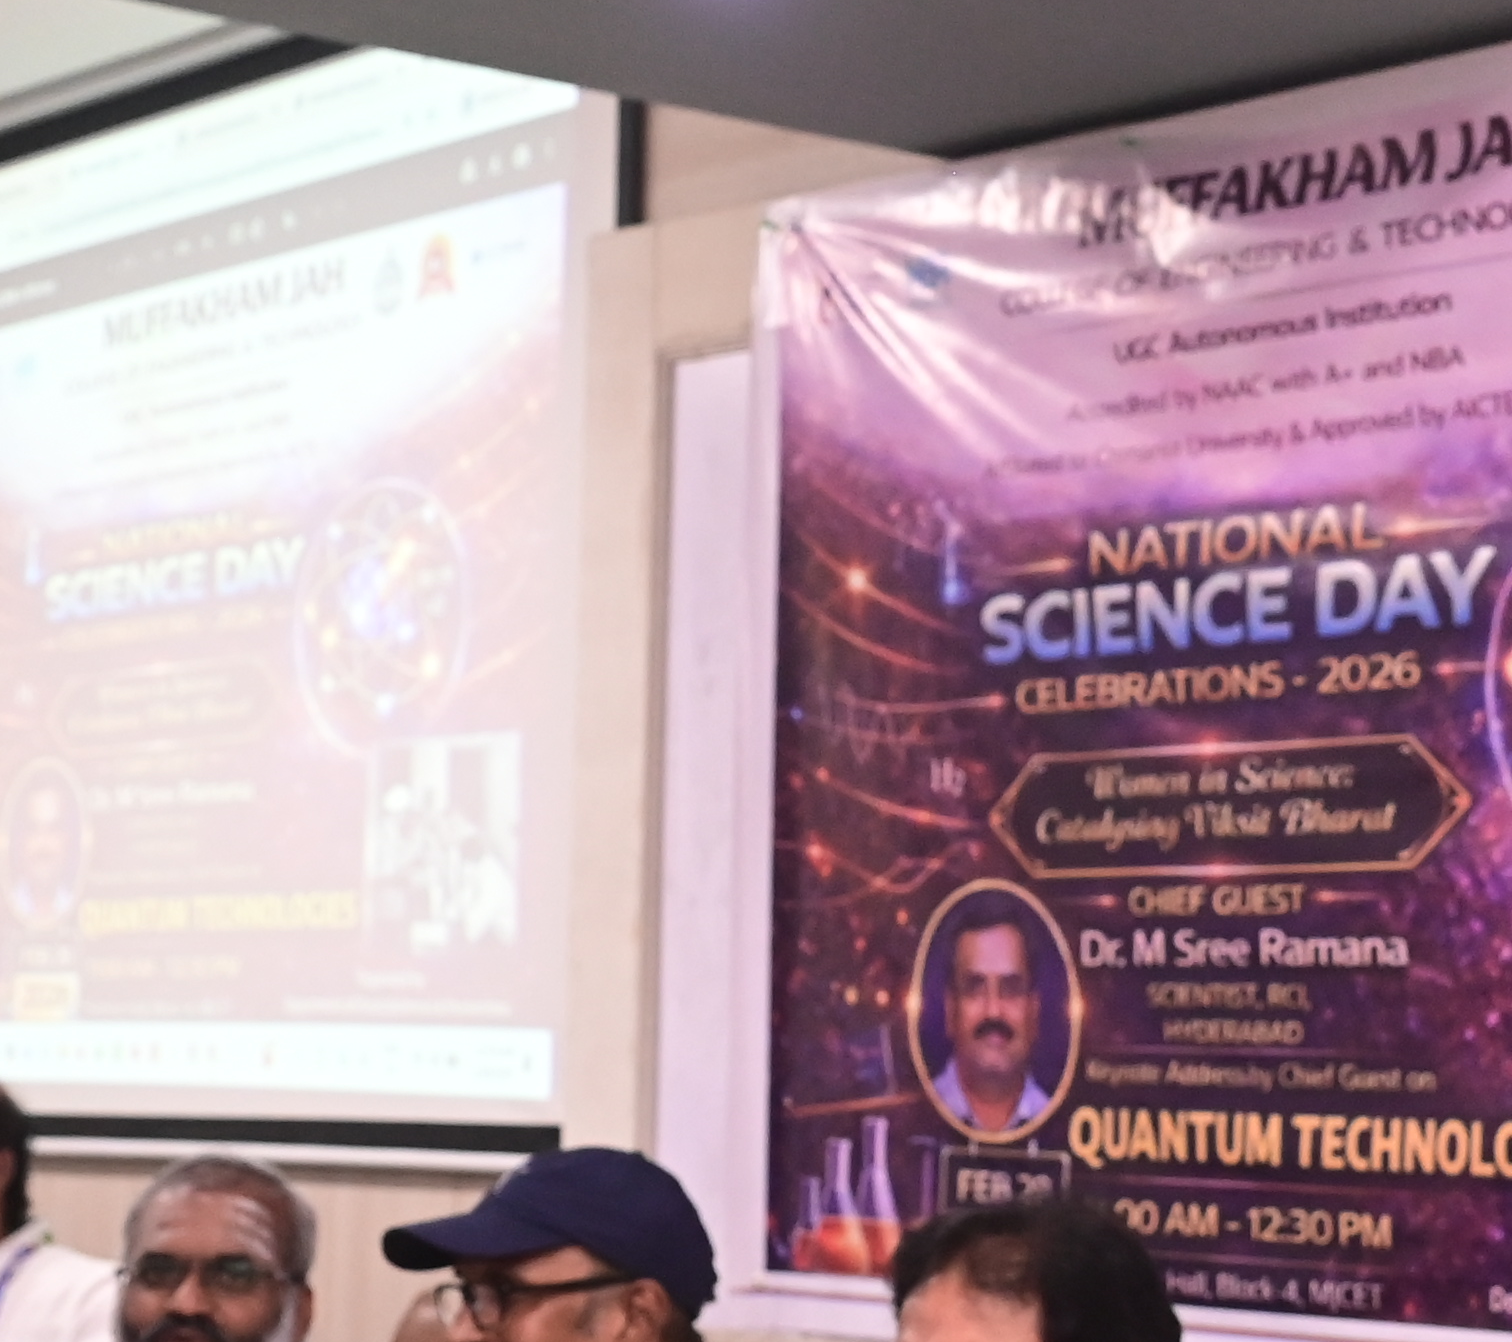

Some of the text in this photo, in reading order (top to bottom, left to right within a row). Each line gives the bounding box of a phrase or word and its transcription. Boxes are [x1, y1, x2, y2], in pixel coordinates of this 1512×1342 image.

[1169, 313, 1319, 353] Autonomous
[1325, 291, 1453, 330] Institution
[1088, 501, 1386, 578] NATIONAL
[979, 544, 1497, 665] SCIENCE DAY
[1015, 658, 1286, 716] CELEBRATIONS
[1317, 651, 1422, 697] 2026
[1084, 760, 1192, 801] Women
[1197, 757, 1231, 796] in
[1127, 883, 1305, 918] CHIEF GUEST
[1079, 927, 1411, 968] Dr. M Sree Ramana
[1068, 1105, 1284, 1169] QUANTUM
[956, 1167, 1013, 1204] FEB
[1163, 1201, 1221, 1239] AM
[1245, 1206, 1335, 1248] 12:30
[1338, 1212, 1393, 1250] PM
